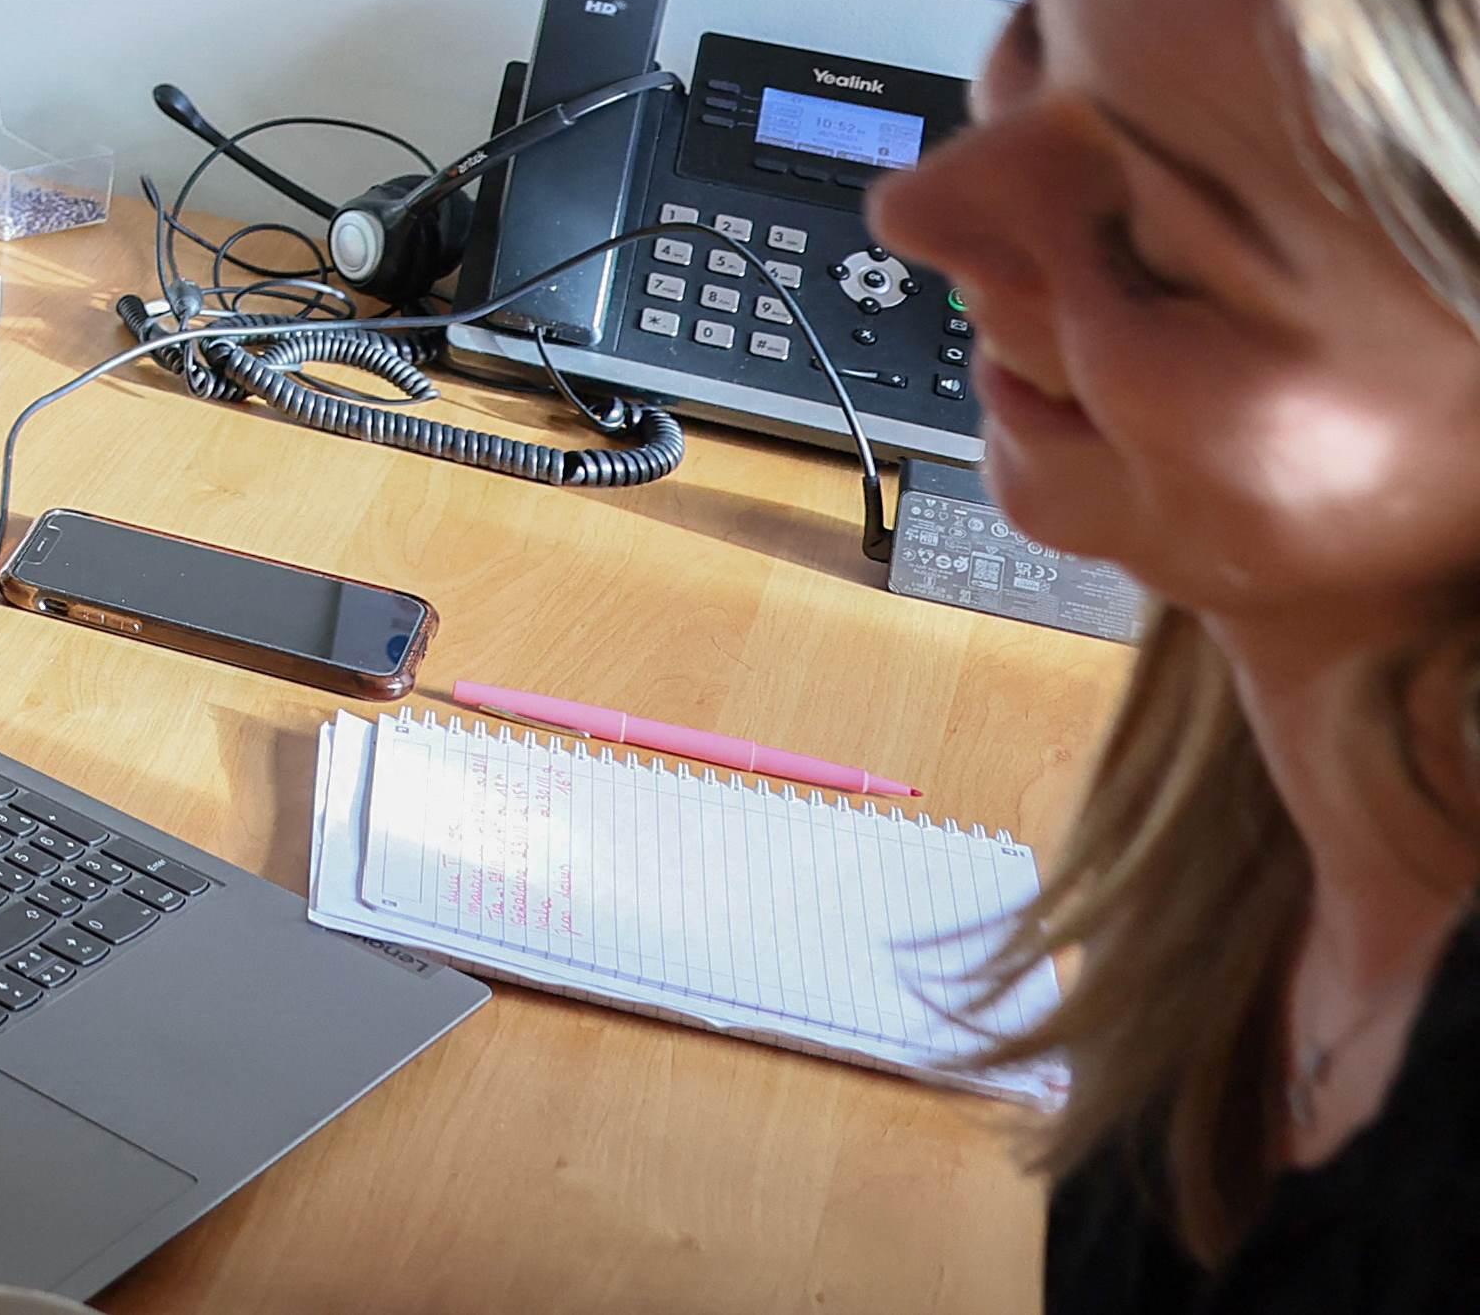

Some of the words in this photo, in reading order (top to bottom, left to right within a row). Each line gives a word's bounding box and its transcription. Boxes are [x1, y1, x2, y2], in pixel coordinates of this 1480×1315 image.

[584, 0, 617, 16] HD
[813, 67, 885, 95] Yealink
[40, 836, 54, 846] 6
[15, 852, 29, 862] 5
[86, 860, 101, 870] 3
[61, 876, 77, 887] 2
[88, 920, 103, 930] 0
